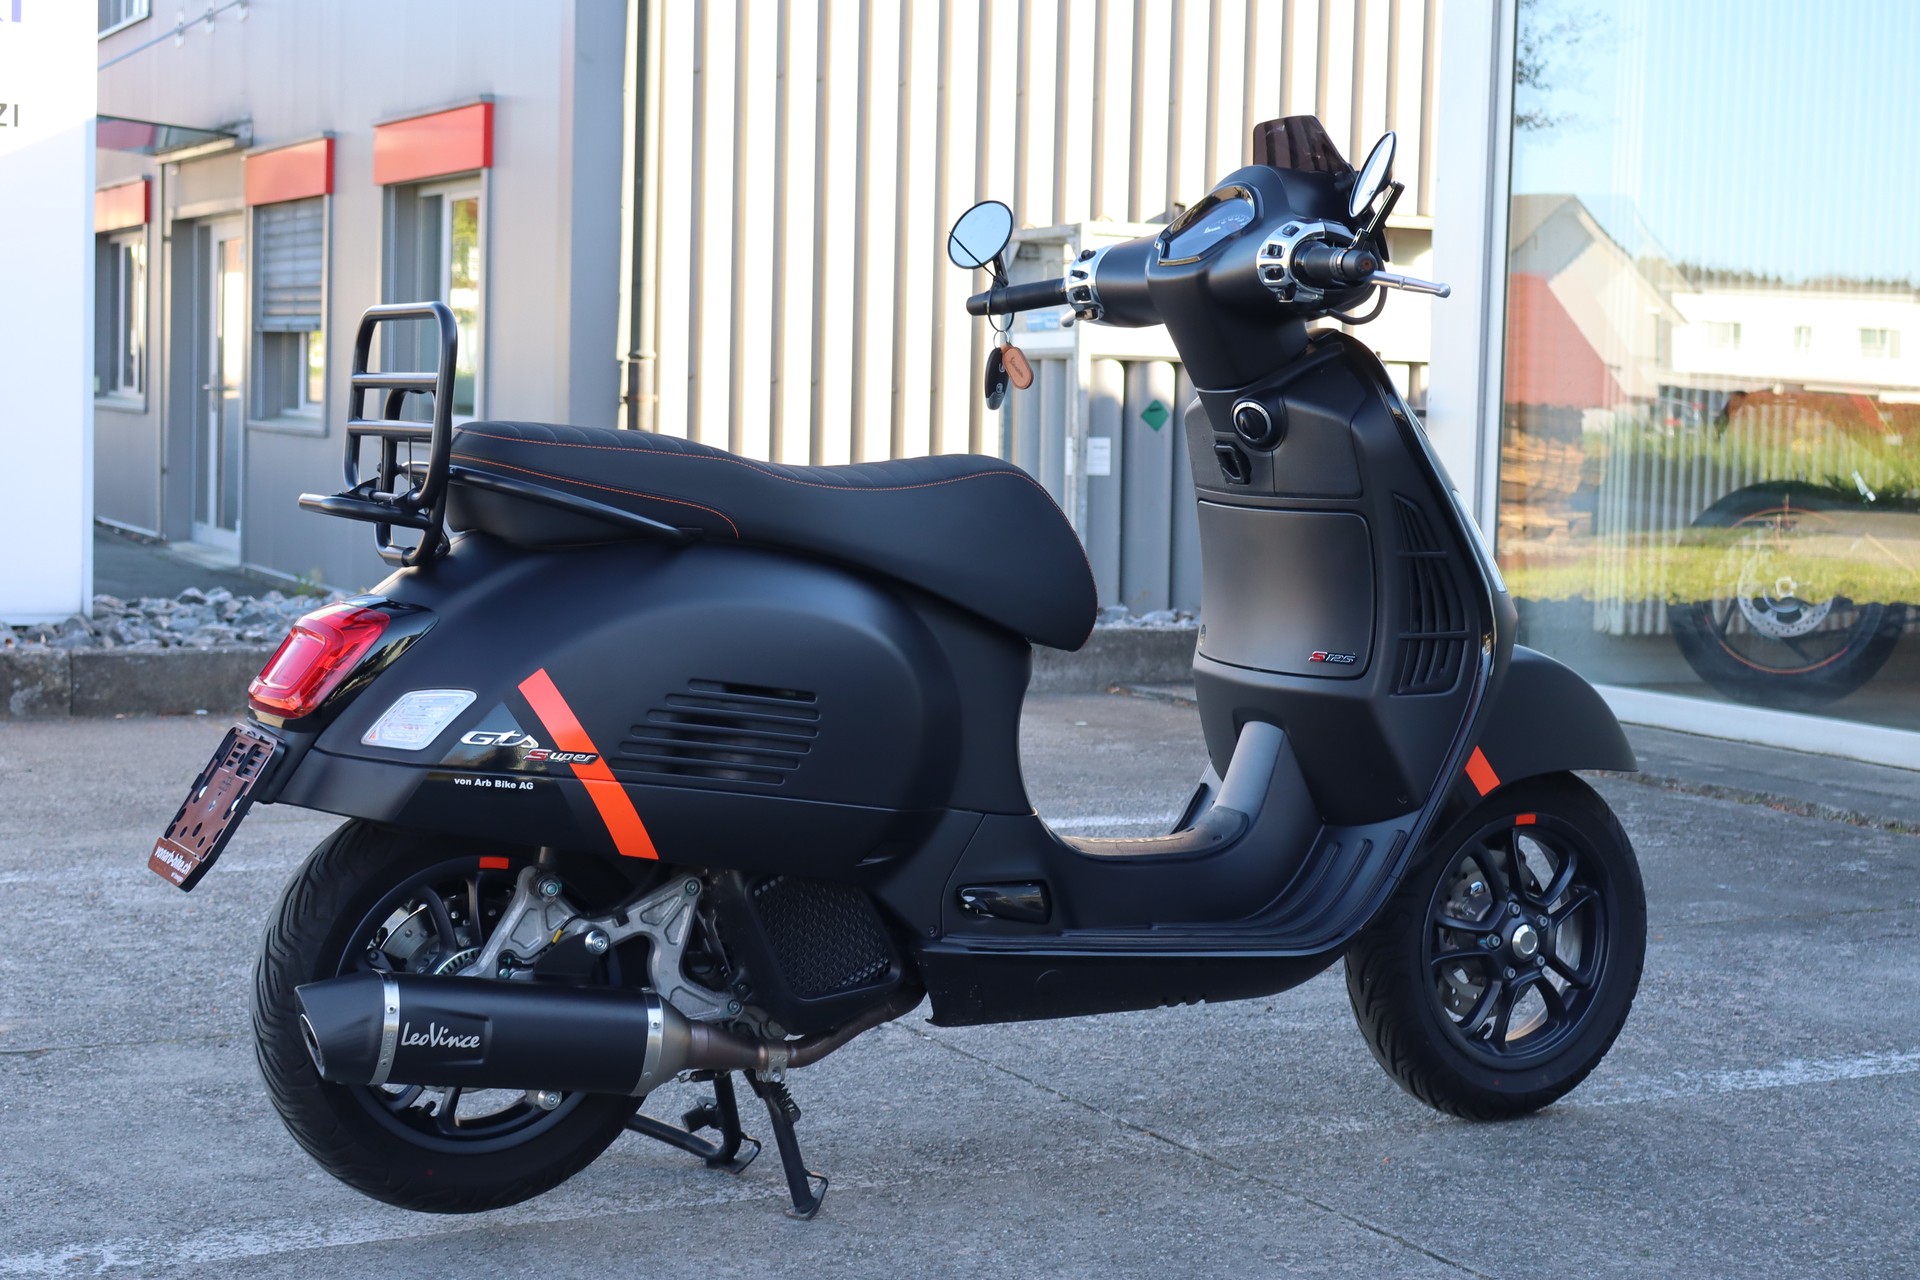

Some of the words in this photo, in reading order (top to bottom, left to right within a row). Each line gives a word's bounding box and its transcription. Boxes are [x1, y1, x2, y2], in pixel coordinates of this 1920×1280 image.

[454, 778, 472, 786] von
[474, 778, 492, 788] Arb
[494, 780, 517, 789] Bike
[519, 781, 534, 790] AG
[400, 1021, 481, 1049] LeoVince
